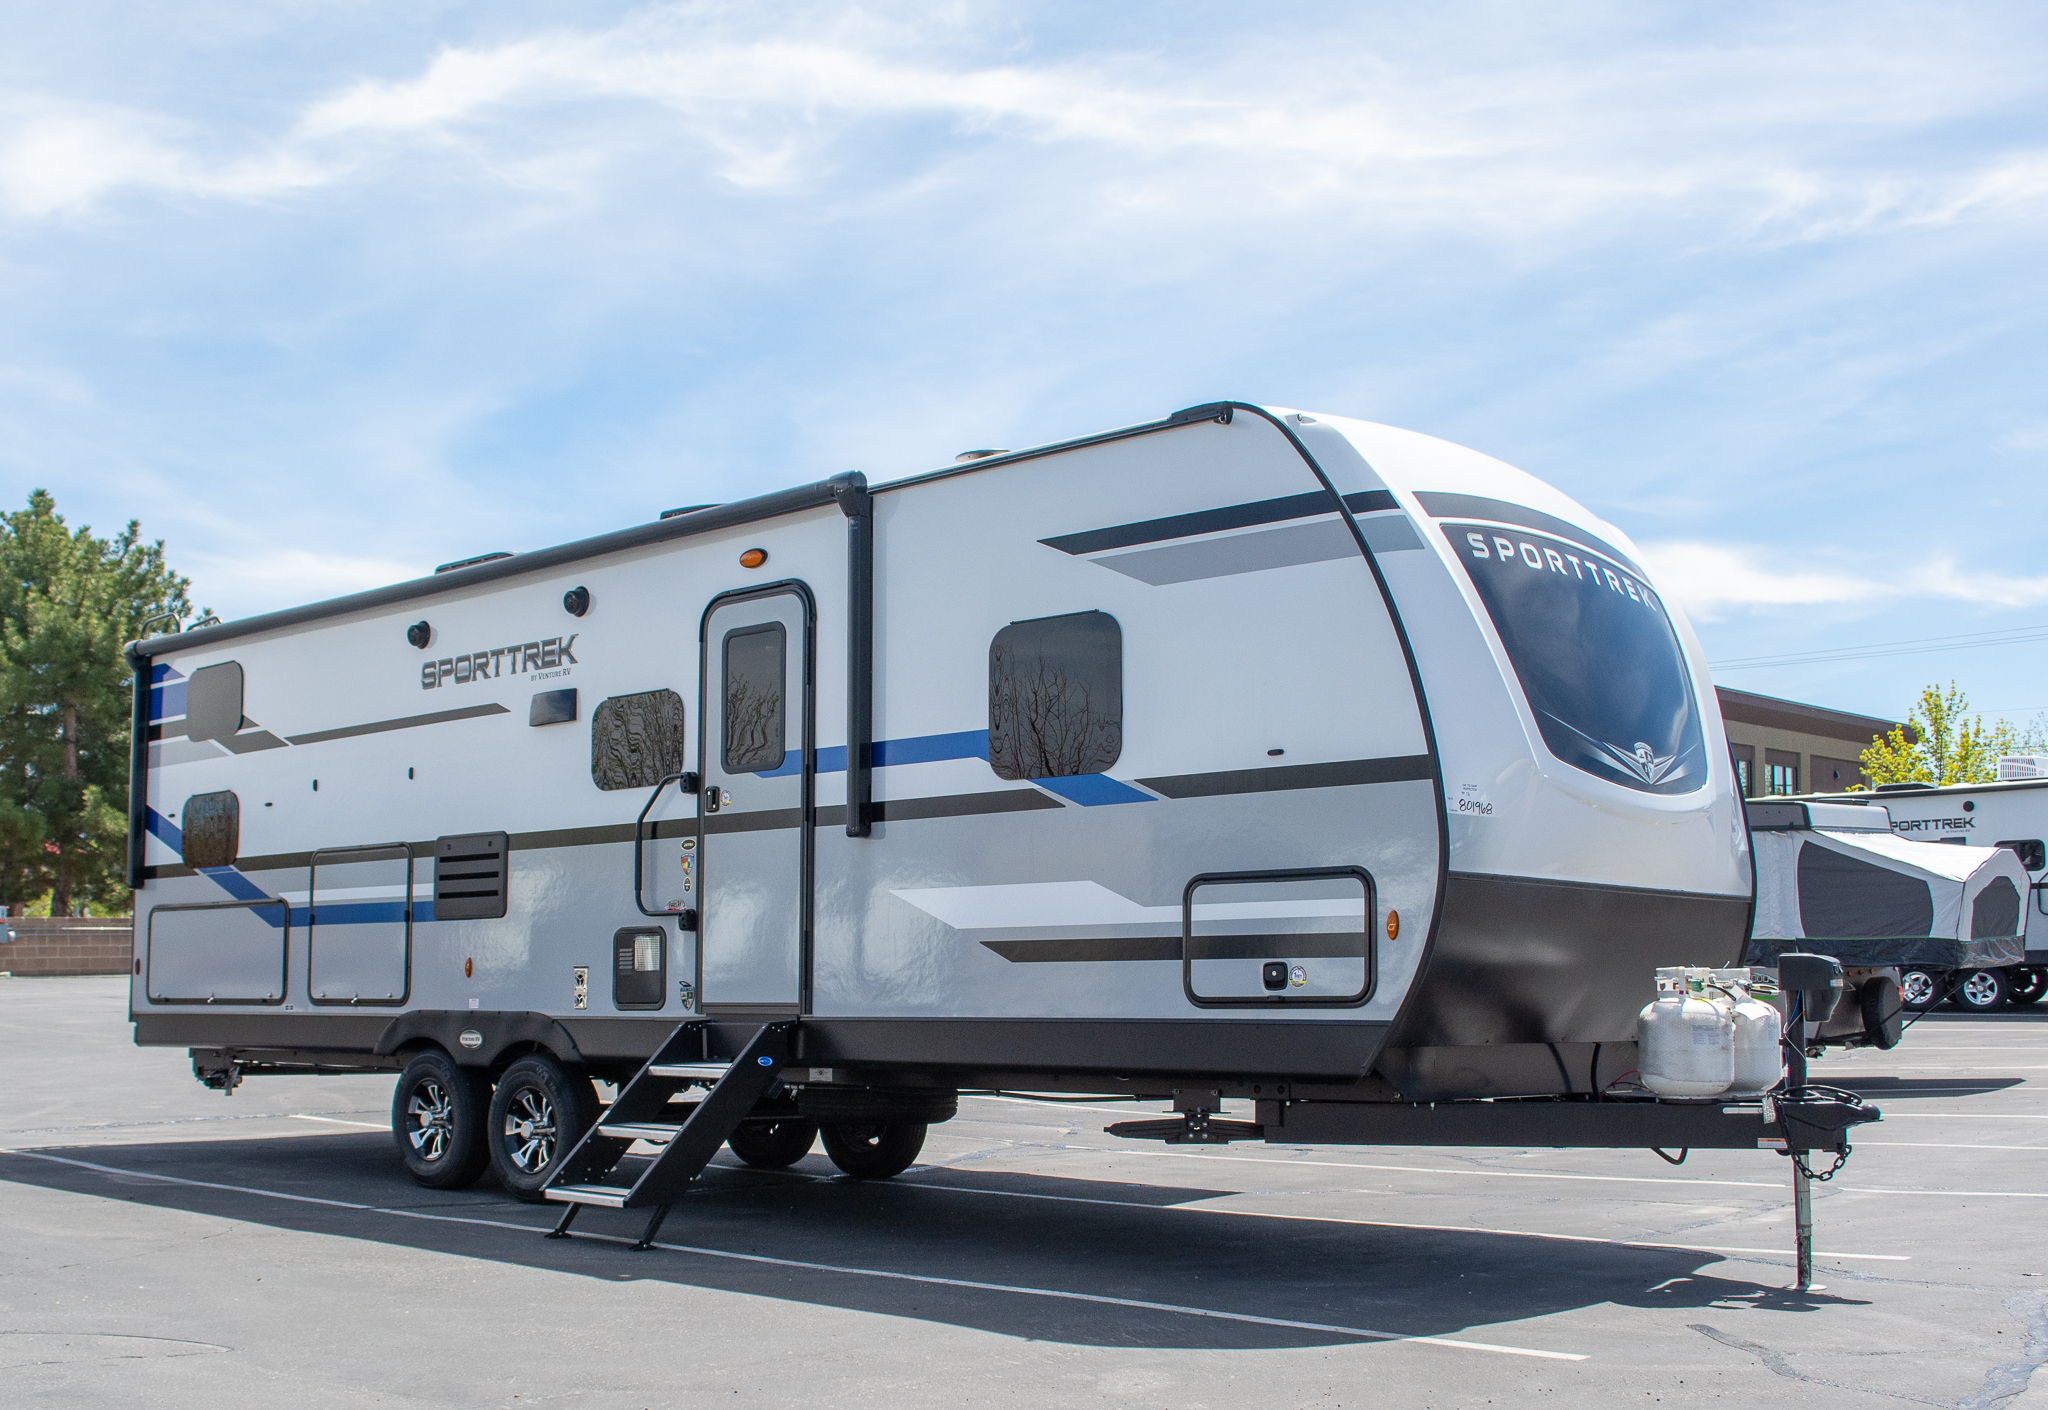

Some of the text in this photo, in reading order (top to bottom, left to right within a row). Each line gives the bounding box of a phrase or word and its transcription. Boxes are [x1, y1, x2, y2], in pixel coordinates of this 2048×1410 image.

[1466, 532, 1656, 611] SPORTTREK
[421, 633, 579, 690] SPORTTREK
[562, 668, 572, 676] RV
[1459, 798, 1493, 815] 801968
[1891, 817, 1976, 831] PORTTREK
